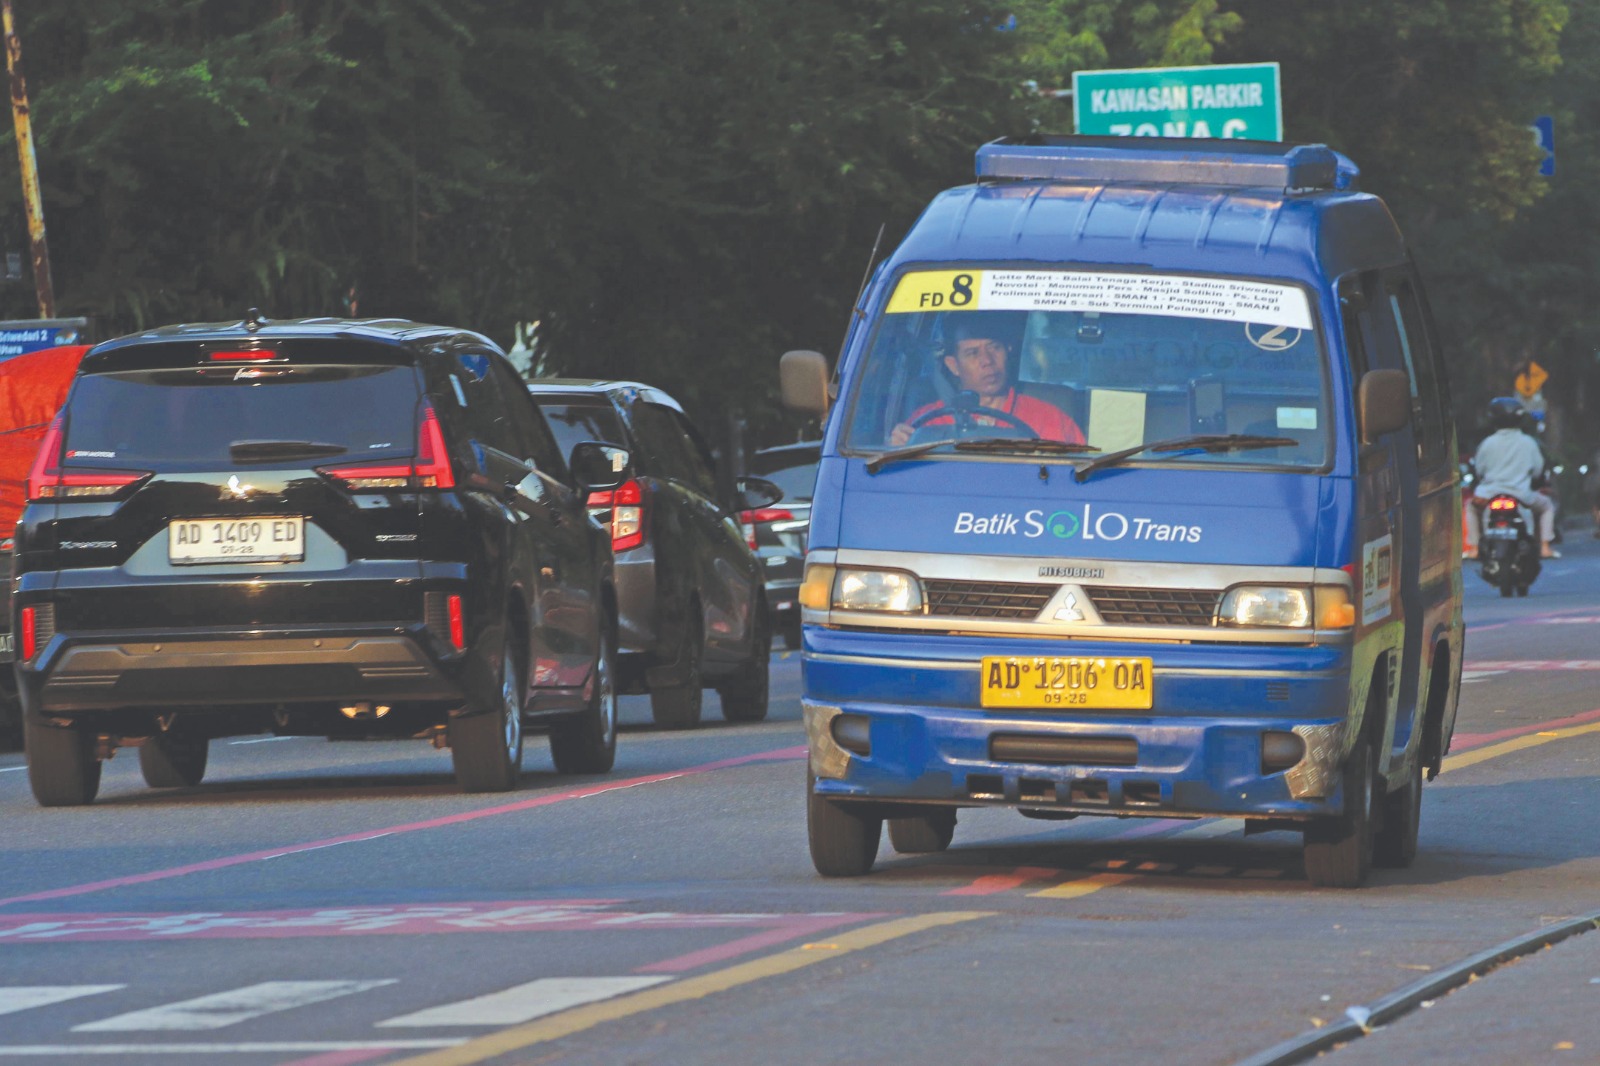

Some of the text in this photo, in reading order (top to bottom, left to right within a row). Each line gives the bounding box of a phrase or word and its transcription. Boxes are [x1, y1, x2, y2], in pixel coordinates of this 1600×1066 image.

[1091, 82, 1263, 114] KAWASAN PARKIR
[919, 274, 973, 307] FD 8
[1049, 282, 1103, 290] Monumen
[1143, 286, 1180, 294] Masjid
[1184, 288, 1222, 297] Solikin
[1254, 295, 1279, 304] Legi
[1096, 276, 1137, 284] Tenaga
[1141, 278, 1171, 286] Kerja
[1229, 284, 1283, 295] Sriwedari
[1113, 301, 1163, 310] Terminal
[1167, 304, 1209, 314] Pelangi
[1212, 307, 1236, 316] (PP)
[1169, 296, 1225, 307] Panggung
[1236, 301, 1270, 310] SMAN
[41, 329, 48, 341] 2
[178, 521, 296, 545] AD 1409 ED
[954, 512, 1020, 535] Batik
[1132, 518, 1202, 543] Trans
[1038, 566, 1105, 579] MITSUBISHI
[988, 661, 1145, 690] AD 1206 OA
